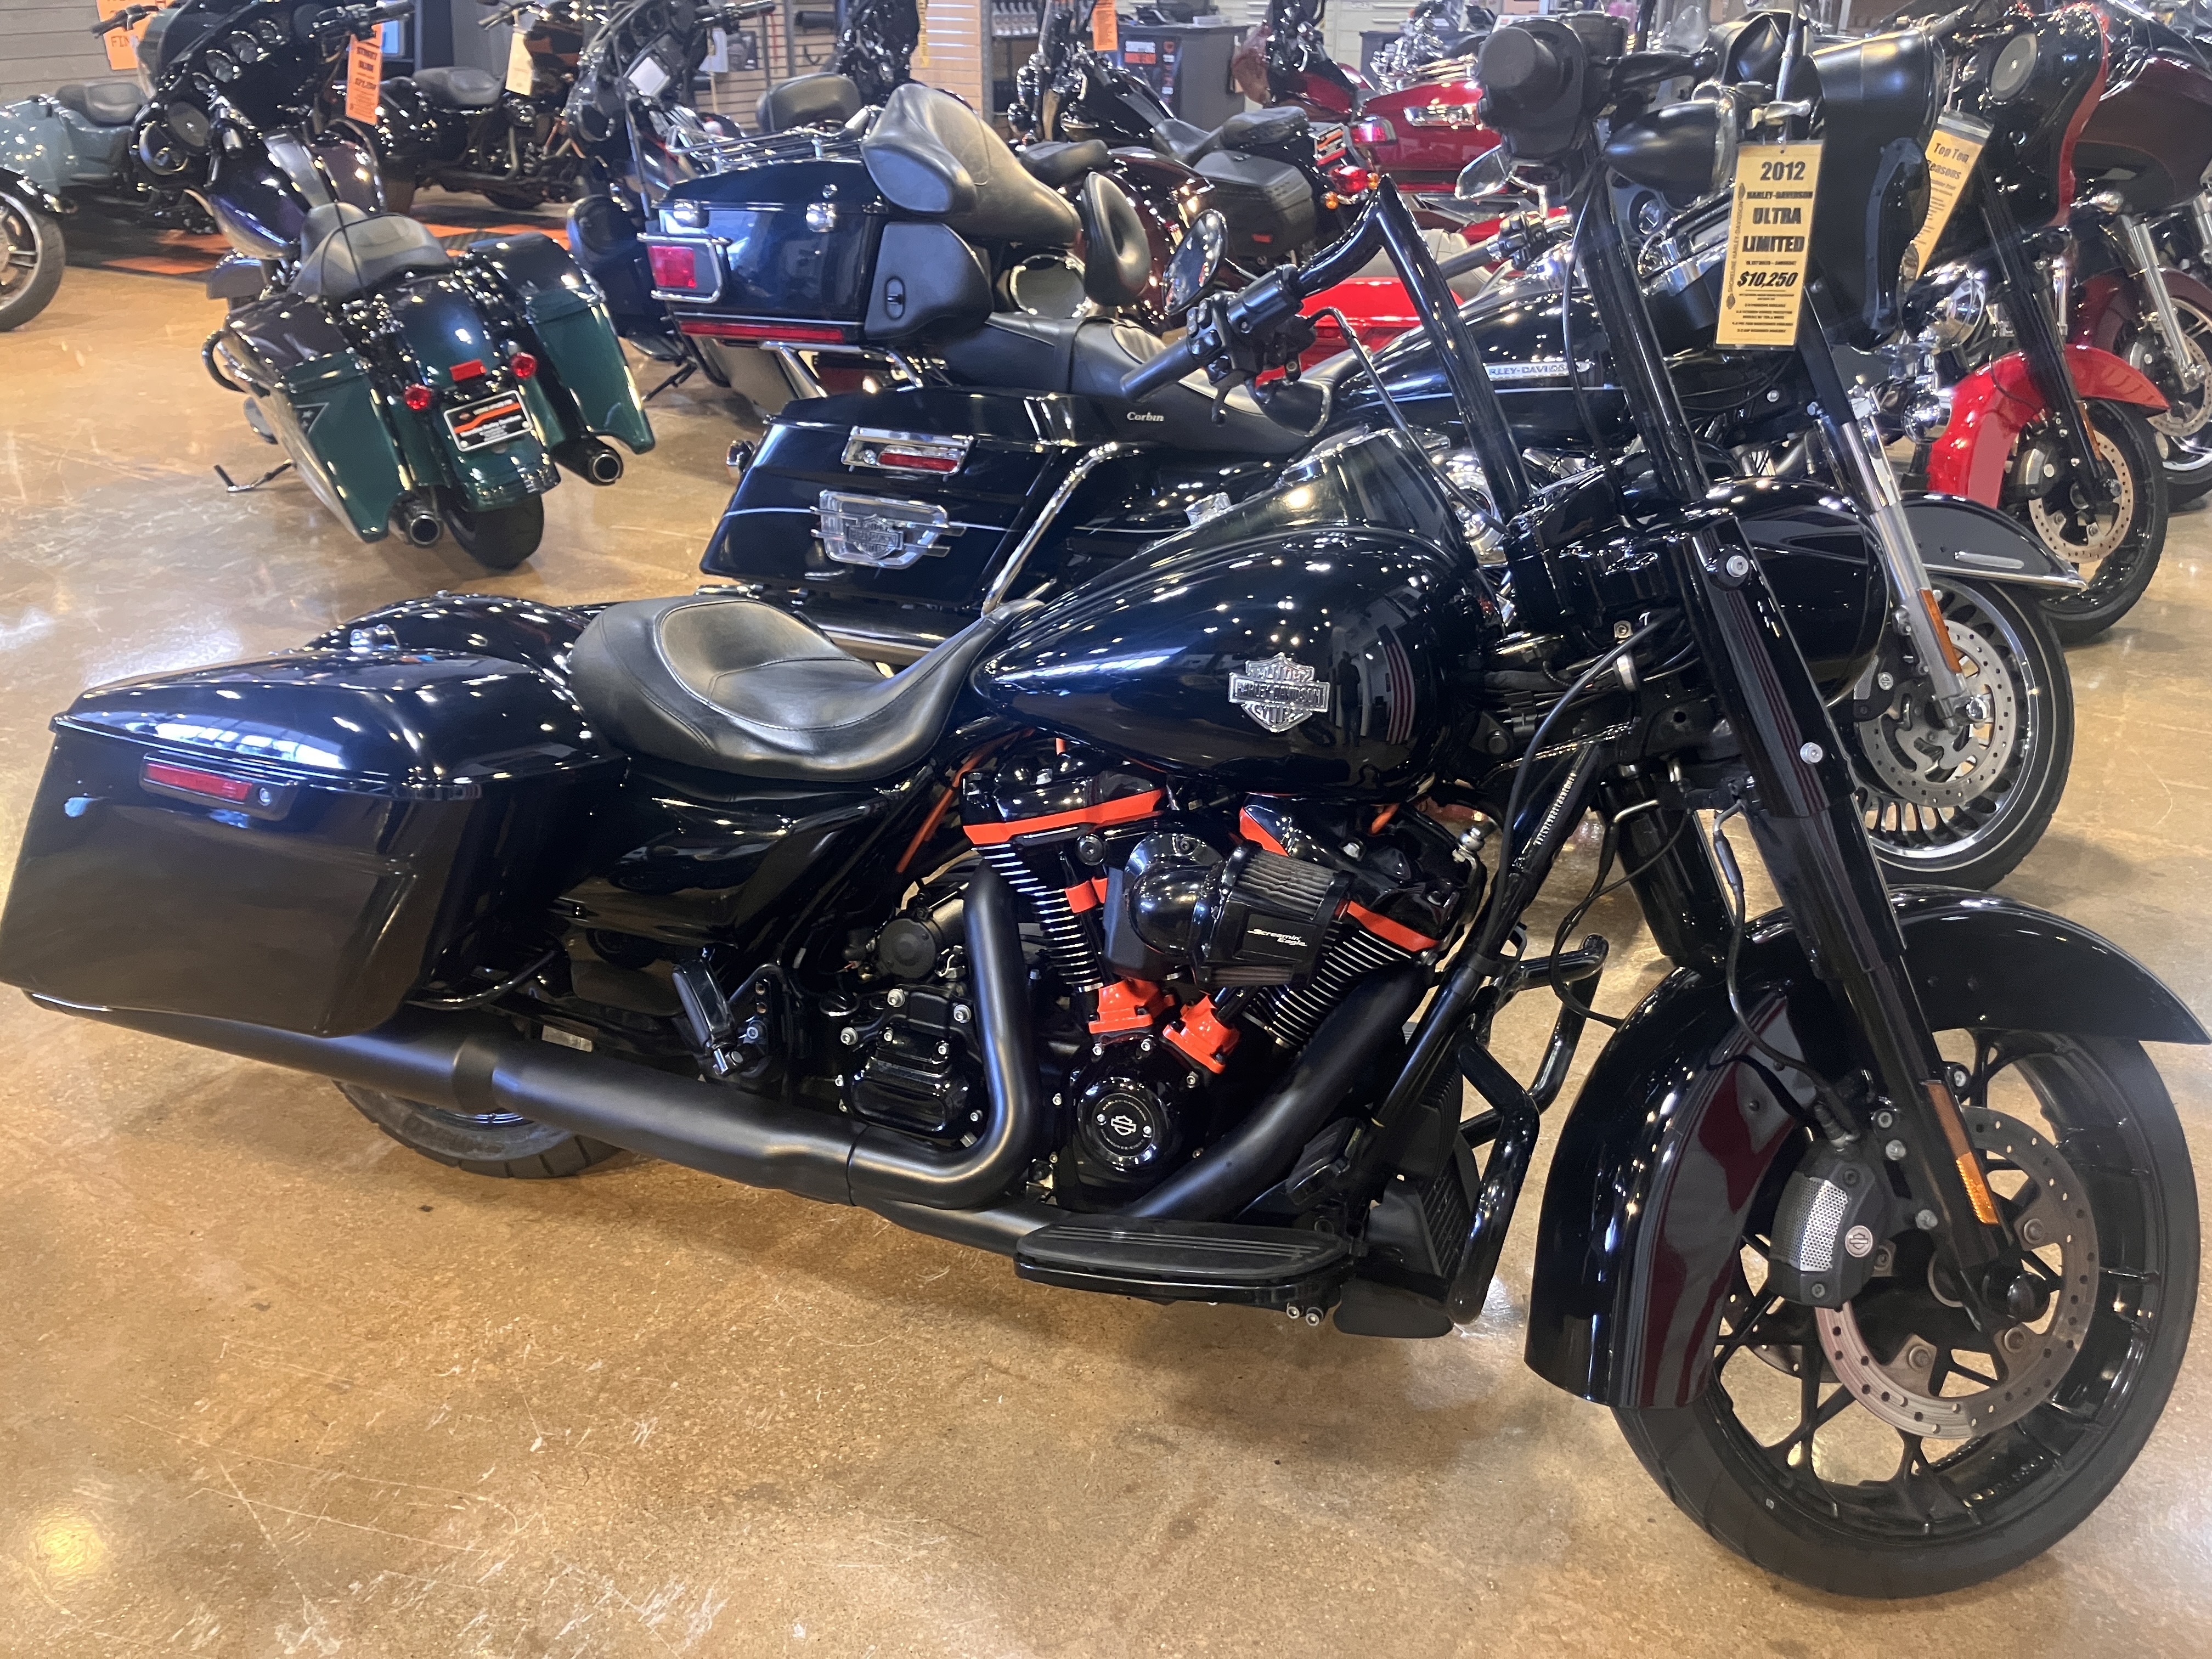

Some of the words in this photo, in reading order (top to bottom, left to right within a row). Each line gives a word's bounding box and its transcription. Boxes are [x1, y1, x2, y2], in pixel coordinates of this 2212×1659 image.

[1934, 143, 1951, 158] Top
[1952, 149, 1970, 163] Ten
[1760, 161, 1805, 181] 2012
[1752, 207, 1802, 224] ULTRA
[1732, 200, 1743, 259] HARLEY-DAVIDSON
[1742, 235, 1805, 252] LIMITED
[1728, 260, 1737, 292] SHORELINE
[1737, 270, 1798, 289] $10,250
[1488, 364, 1567, 376] RLEY-DAVIDS
[1127, 411, 1165, 422] Corbin
[1277, 938, 1308, 947] Eagle
